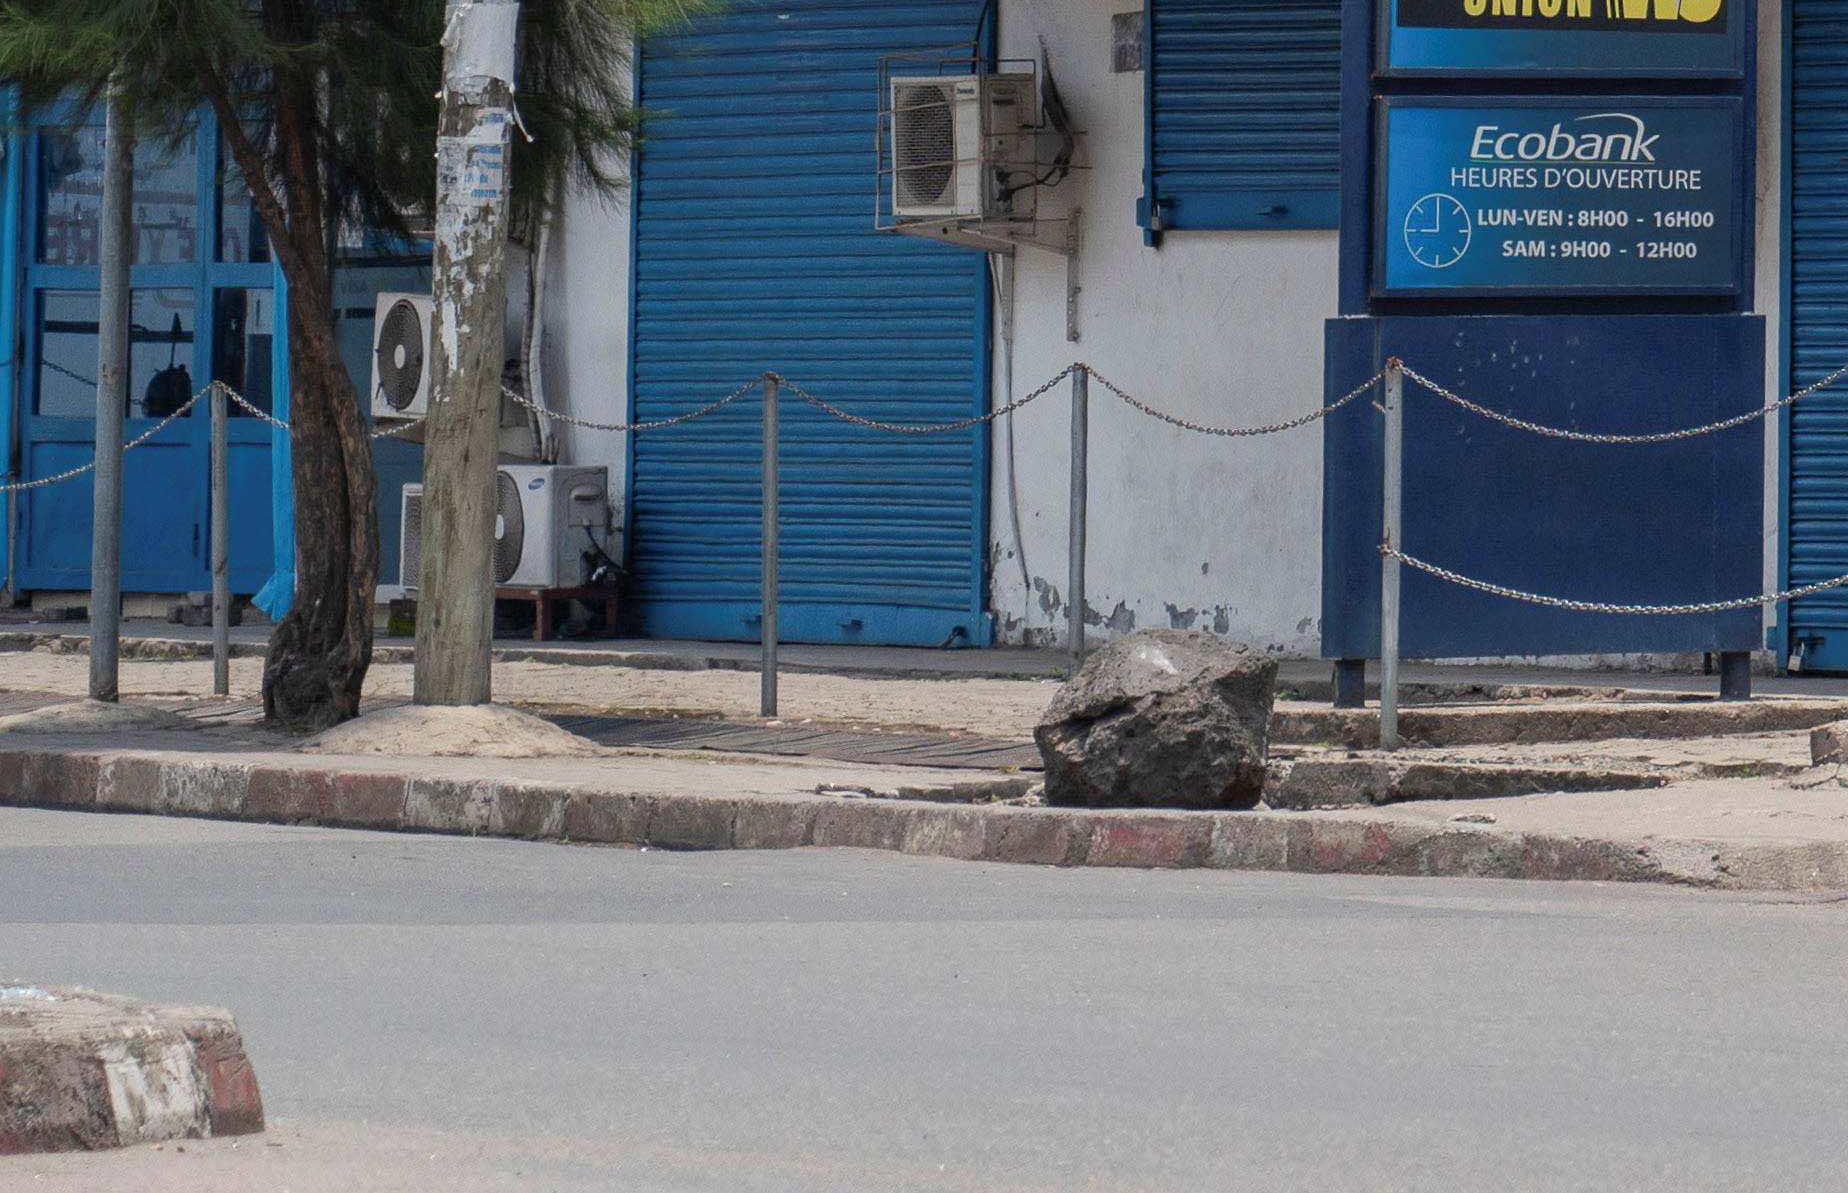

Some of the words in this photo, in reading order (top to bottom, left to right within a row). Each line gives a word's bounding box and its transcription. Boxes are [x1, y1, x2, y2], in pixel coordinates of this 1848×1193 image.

[1469, 113, 1661, 162] Ecobank
[1450, 167, 1538, 188] HEURES
[1577, 210, 1629, 227] 8H00
[1653, 211, 1715, 228] 16H00
[1560, 242, 1611, 258] 9H00
[1636, 242, 1697, 258] 12H00
